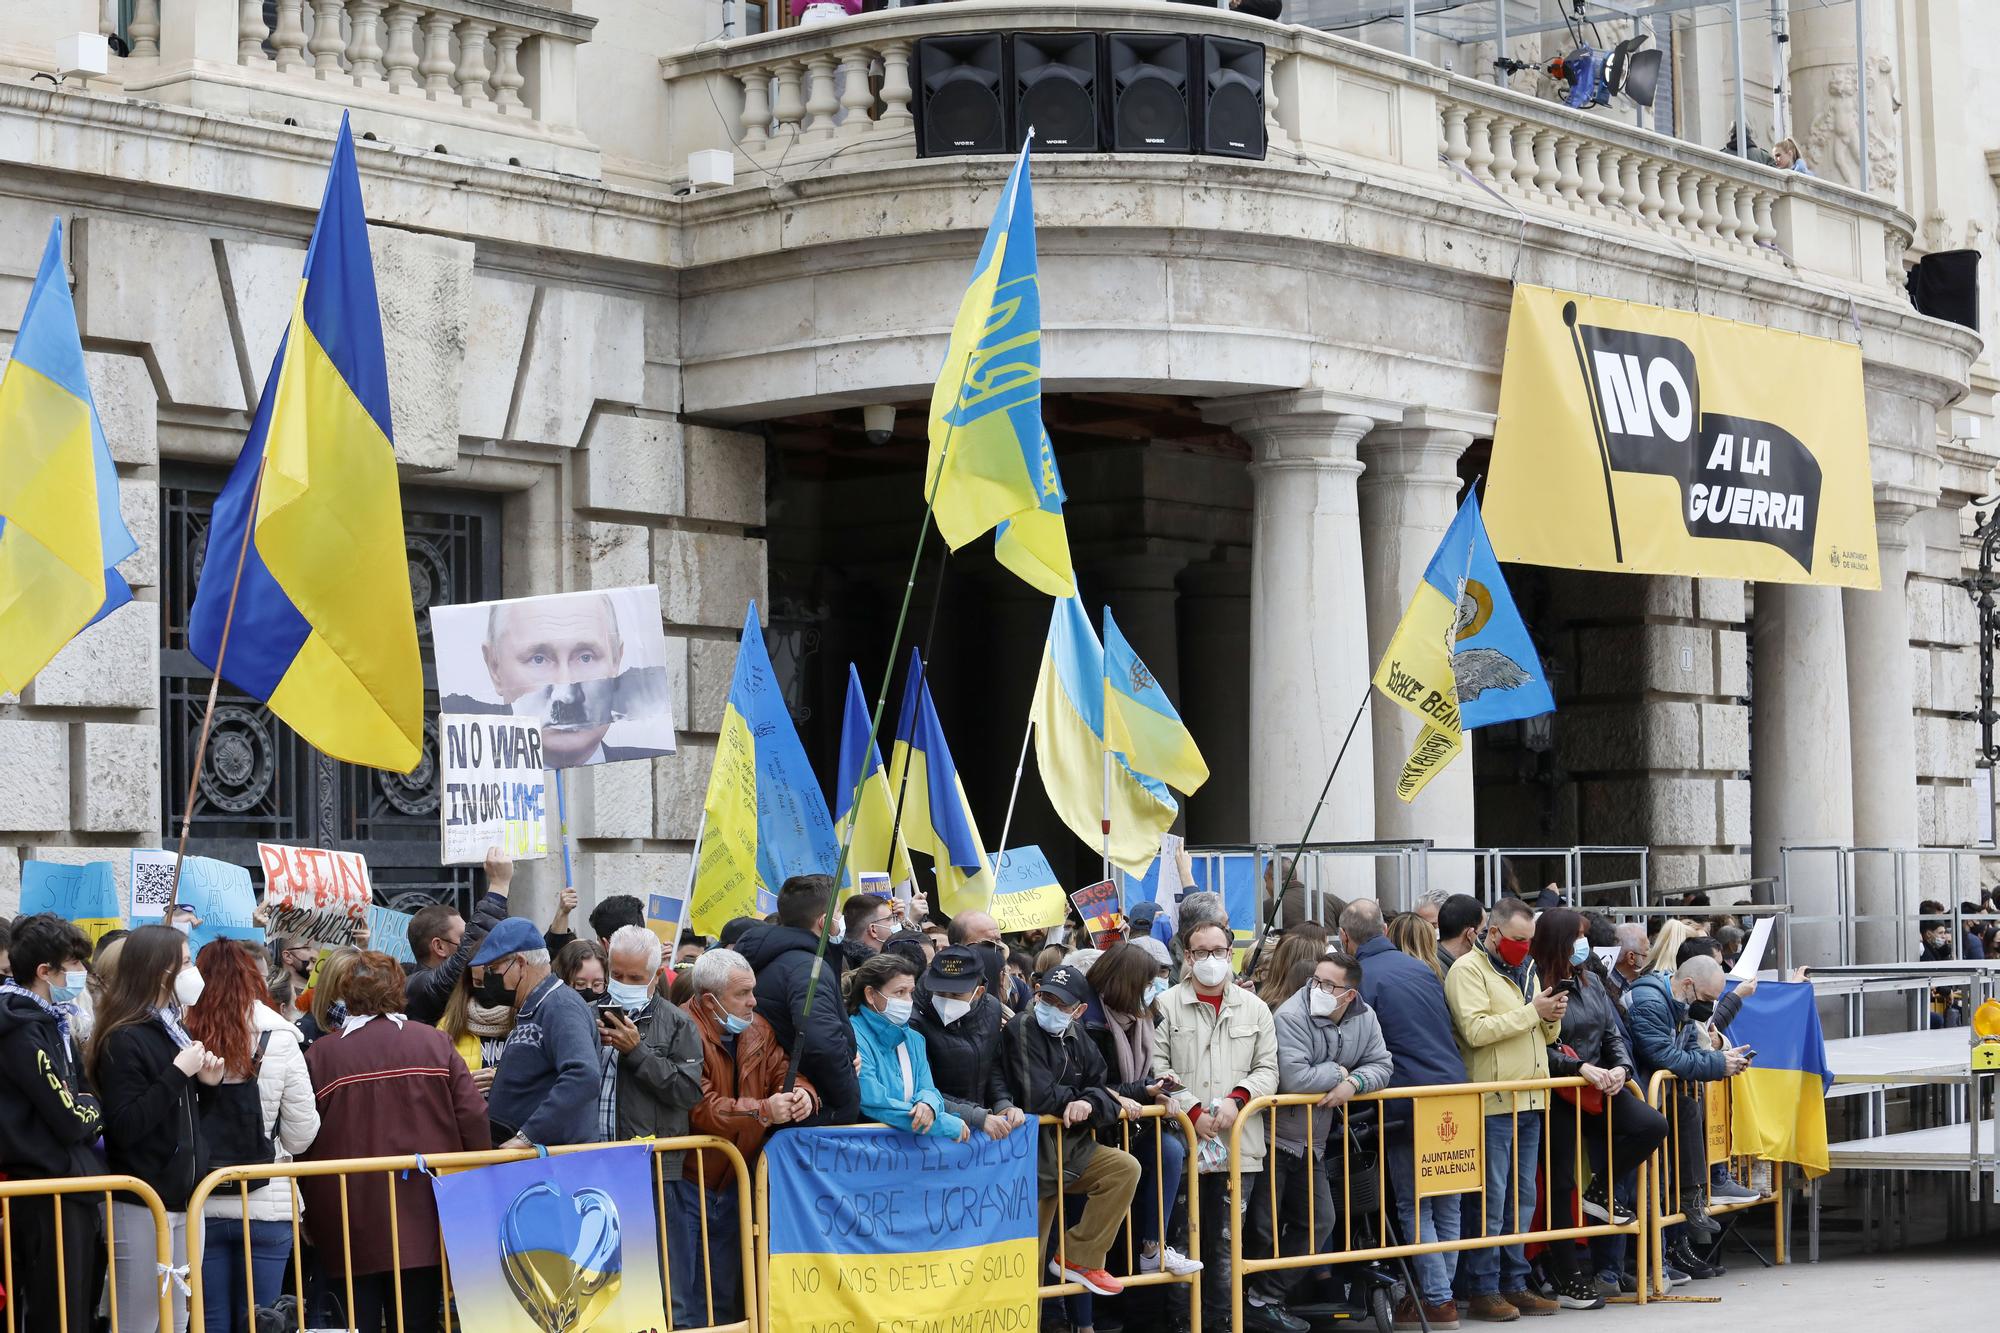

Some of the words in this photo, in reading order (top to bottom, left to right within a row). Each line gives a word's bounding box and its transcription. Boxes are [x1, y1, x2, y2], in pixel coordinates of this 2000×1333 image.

[1593, 350, 1692, 442] NO
[1706, 433, 1733, 471] A
[1740, 437, 1771, 477] LA
[1689, 483, 1805, 532] GUERRA
[446, 722, 482, 769] NO
[488, 724, 543, 770] WAR
[446, 783, 478, 826] IN
[480, 782, 503, 823] OUR
[260, 845, 369, 902] PUTIN
[914, 1135, 951, 1172] EL
[1421, 1148, 1476, 1164] AJUNTAMENT
[1421, 1167, 1433, 1177] DE
[1435, 1162, 1476, 1176] VALÈNCIA
[814, 1190, 905, 1238] SOBRE
[924, 1176, 1033, 1236] UCRANIA
[791, 1267, 821, 1294] NO
[837, 1266, 877, 1294] NOS
[983, 1252, 1025, 1283] SOLO
